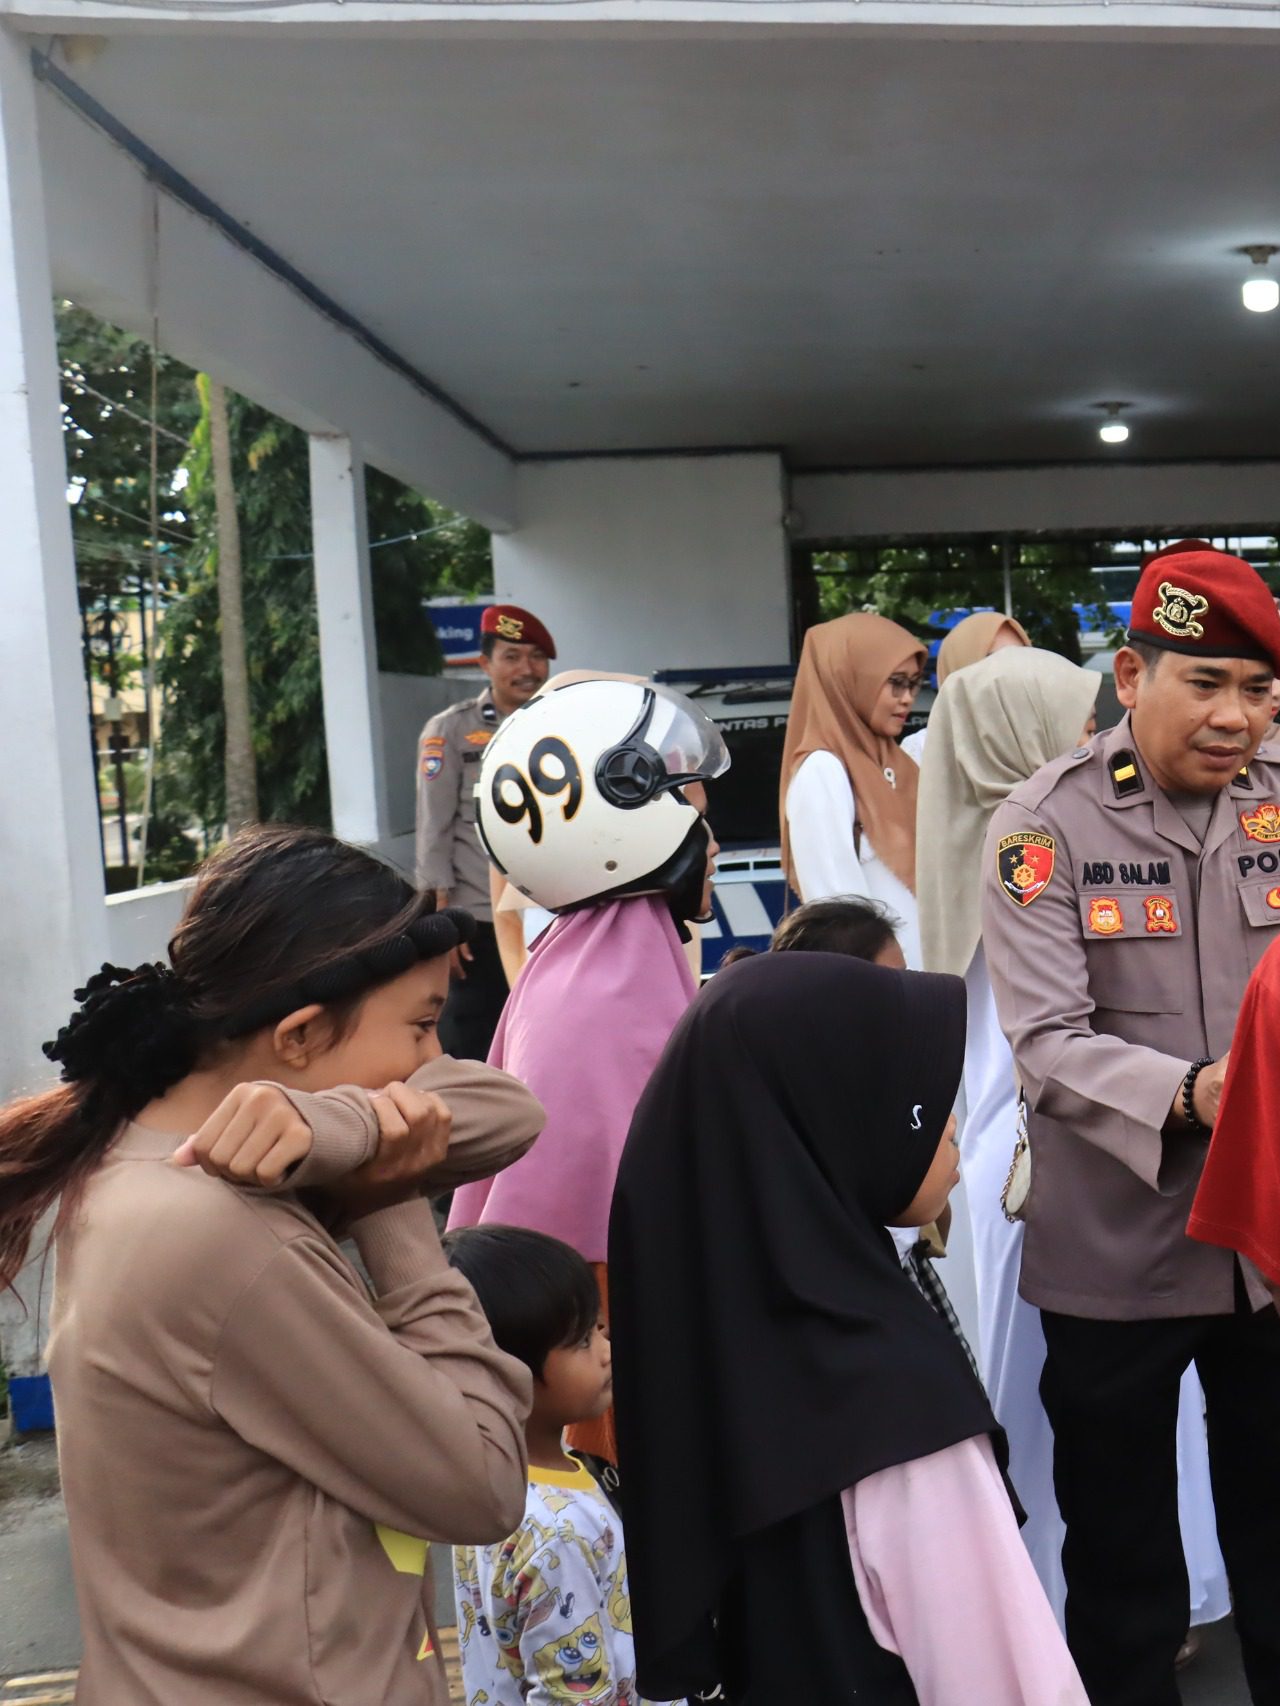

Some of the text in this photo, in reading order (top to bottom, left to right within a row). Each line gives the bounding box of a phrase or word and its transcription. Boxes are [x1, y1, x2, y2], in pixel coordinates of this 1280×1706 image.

[491, 736, 583, 845] 99
[1001, 834, 1052, 848] BARESKRIM
[1119, 862, 1171, 885] SALAM
